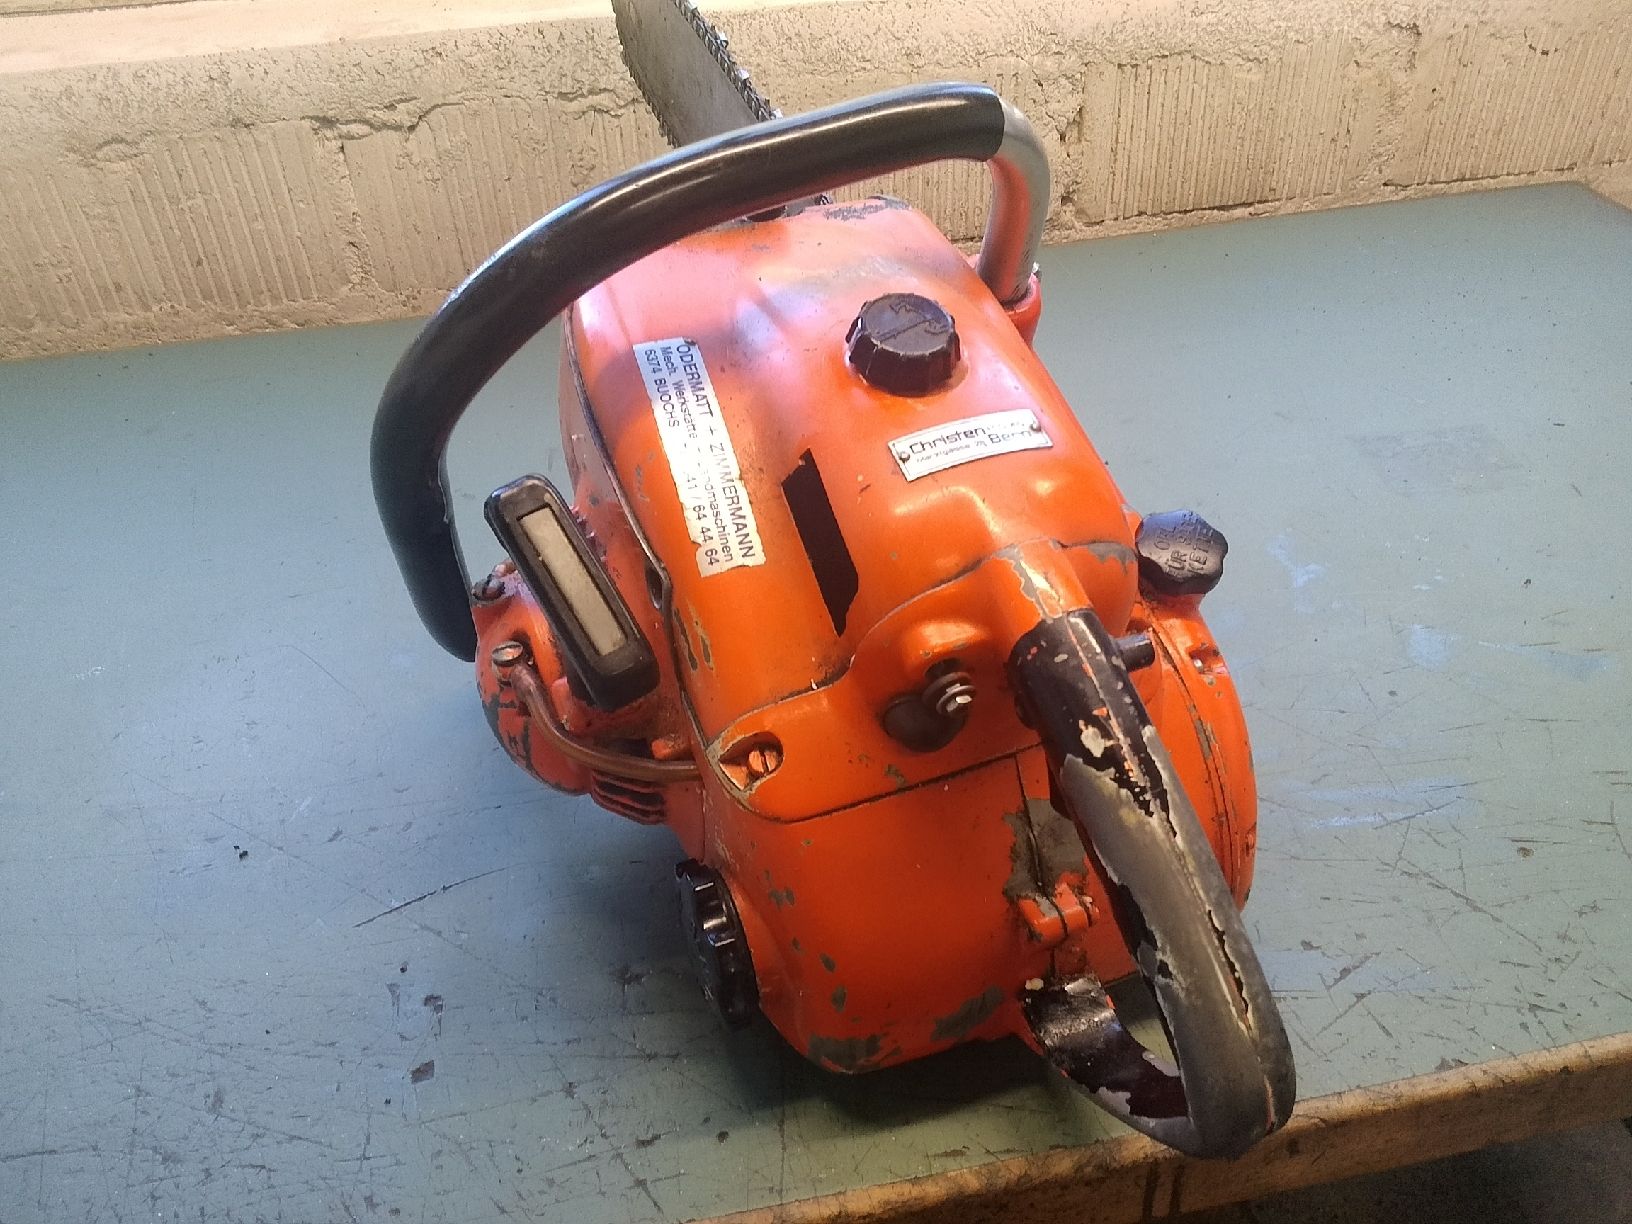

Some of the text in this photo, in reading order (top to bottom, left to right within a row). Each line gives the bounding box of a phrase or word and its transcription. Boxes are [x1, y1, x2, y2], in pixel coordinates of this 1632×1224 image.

[644, 349, 663, 374] 6374
[653, 378, 680, 428] BUOCHS
[909, 427, 987, 454] Christen
[988, 430, 1033, 444] Bern
[677, 343, 714, 418] ODERMATT
[709, 442, 756, 559] ZIMMERMANN
[692, 503, 708, 521] 64
[699, 525, 713, 544] 44
[704, 547, 720, 567] 64
